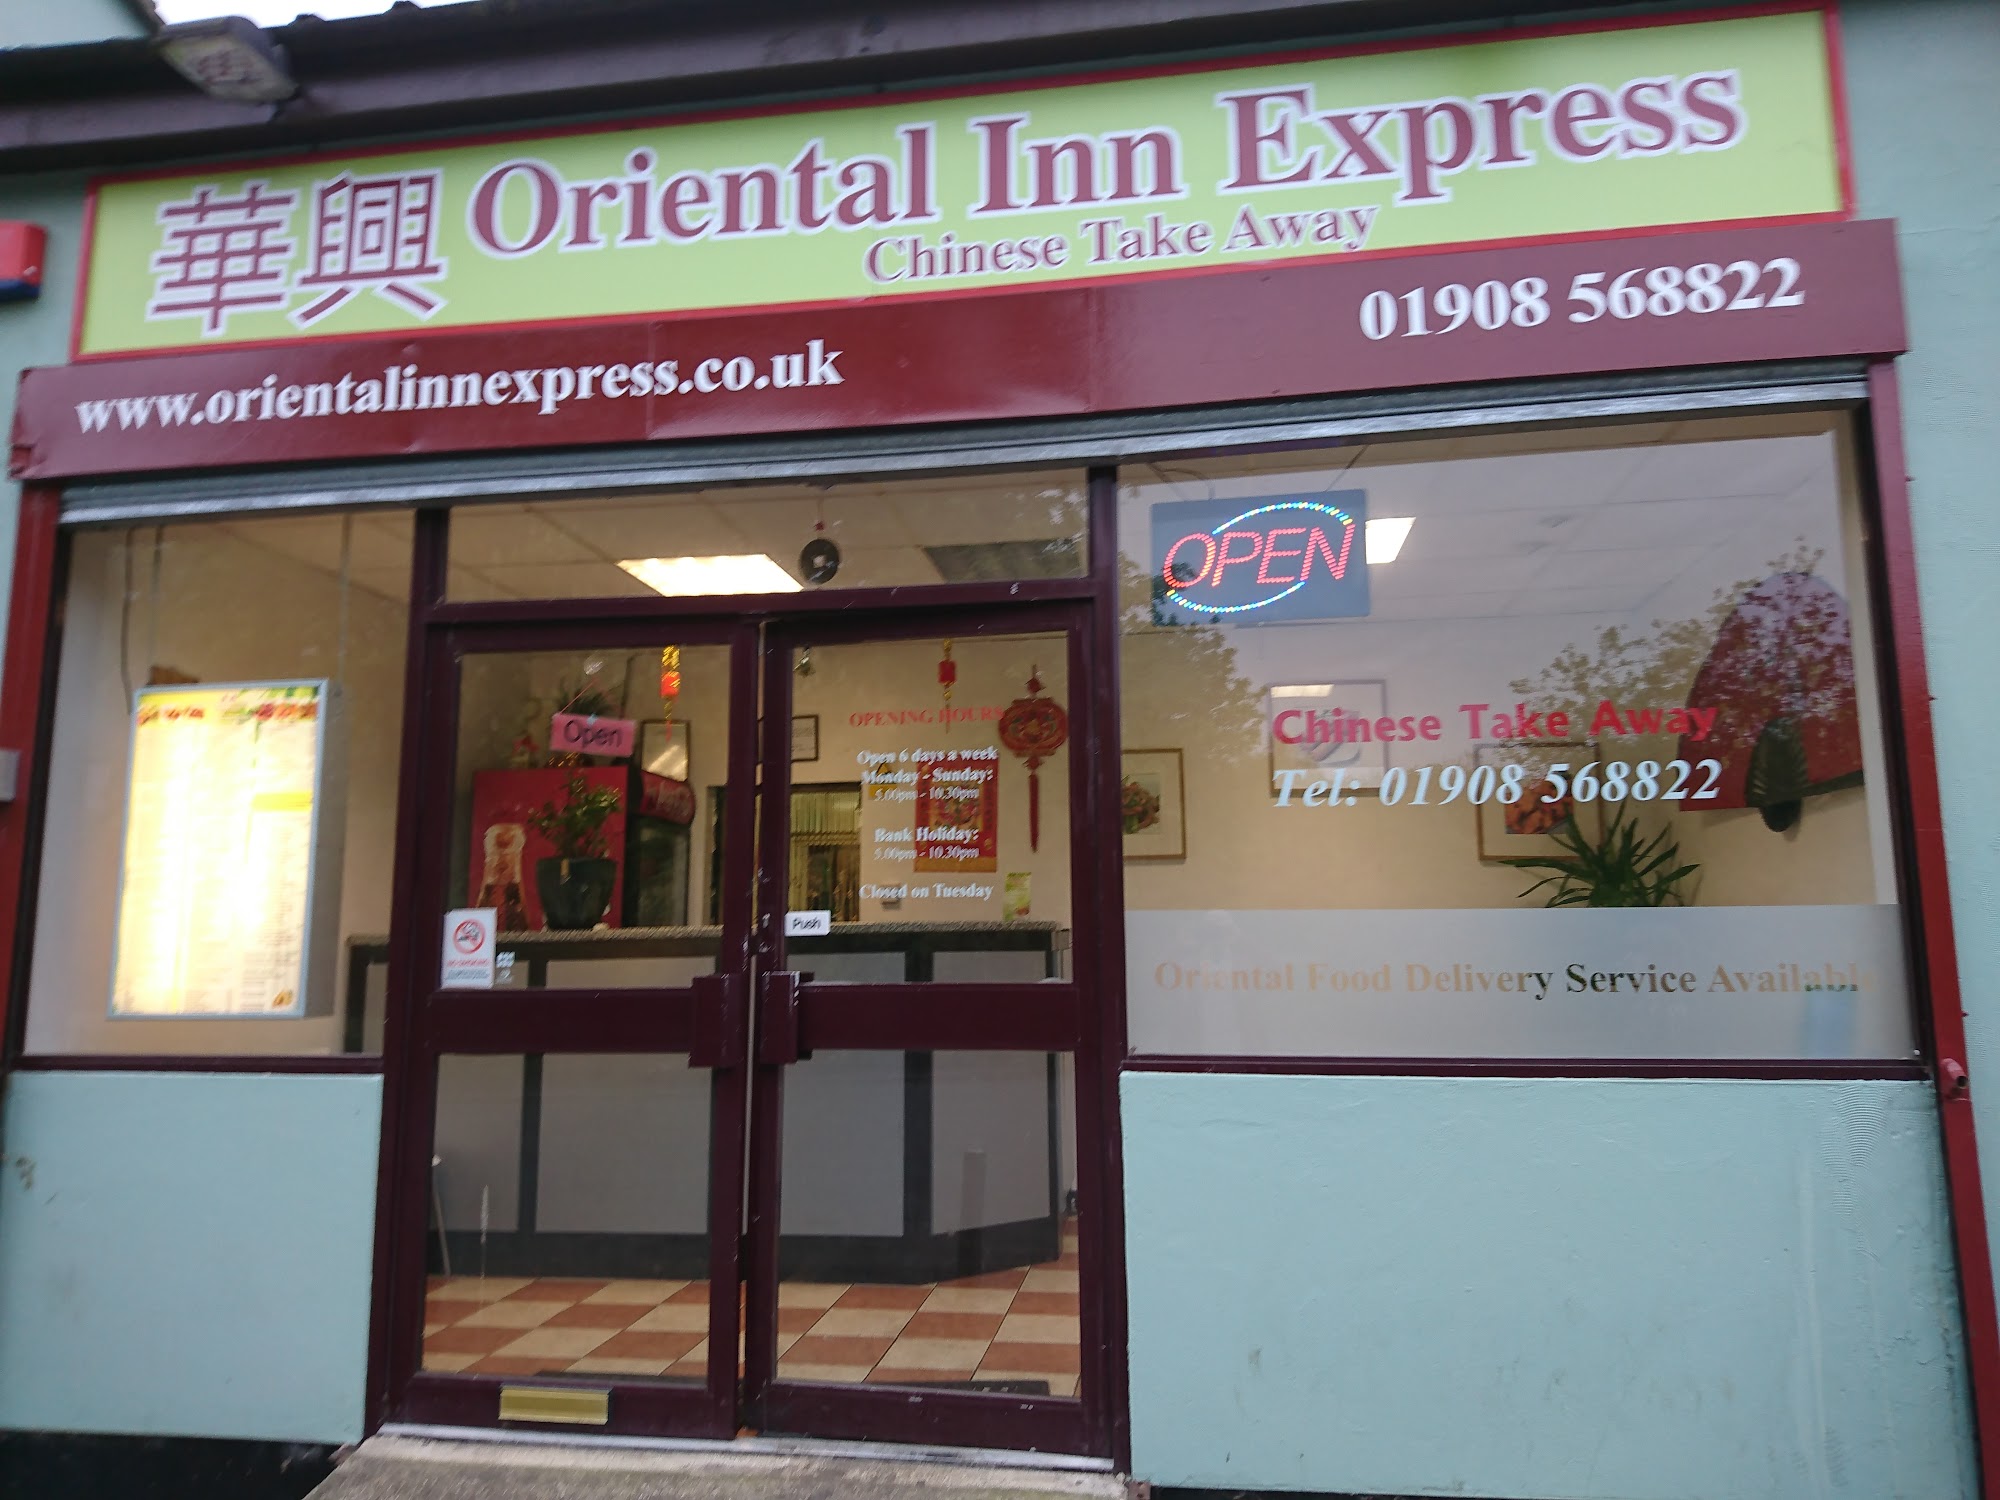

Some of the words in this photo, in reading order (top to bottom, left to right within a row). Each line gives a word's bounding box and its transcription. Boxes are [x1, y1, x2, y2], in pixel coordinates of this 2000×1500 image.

[468, 124, 938, 256] Oriental
[970, 113, 1185, 216] Inn
[1218, 70, 1743, 204] Express
[147, 172, 447, 335] 華興
[866, 233, 1067, 283] Chinese
[1081, 214, 1212, 264] Take
[1222, 202, 1379, 251] Away
[1359, 276, 1550, 340] 01908
[1567, 257, 1806, 323] 568822
[75, 338, 845, 433] www.orientalinnexpress.co.uk
[1163, 524, 1356, 589] OPEN
[563, 718, 623, 748] Open
[849, 708, 933, 728] OPENING
[938, 706, 1004, 723] HOURS
[1272, 708, 1441, 745] Chinese
[1458, 703, 1570, 741] Take
[1588, 700, 1719, 742] Away
[857, 749, 897, 767] Open
[898, 748, 909, 763] 6
[911, 747, 946, 765] days
[947, 751, 958, 762] a
[960, 745, 999, 761] week
[861, 768, 919, 786] Monday
[932, 766, 994, 785] Sunday:
[1272, 767, 1360, 808] Tel:
[1379, 763, 1524, 808] 01908
[1541, 758, 1723, 805] 568822
[929, 785, 980, 803] 10.30pm
[874, 826, 914, 843] Bank
[916, 825, 980, 845] Holiday:
[928, 844, 980, 862] 10.30pm
[859, 882, 909, 899] Closed
[911, 884, 930, 898] on
[932, 882, 994, 902] Tuesday
[792, 916, 822, 930] Push
[1154, 960, 1296, 992] Oriental
[1307, 962, 1393, 992] Food
[1406, 962, 1553, 1001] Delivery
[1566, 963, 1697, 993] Service
